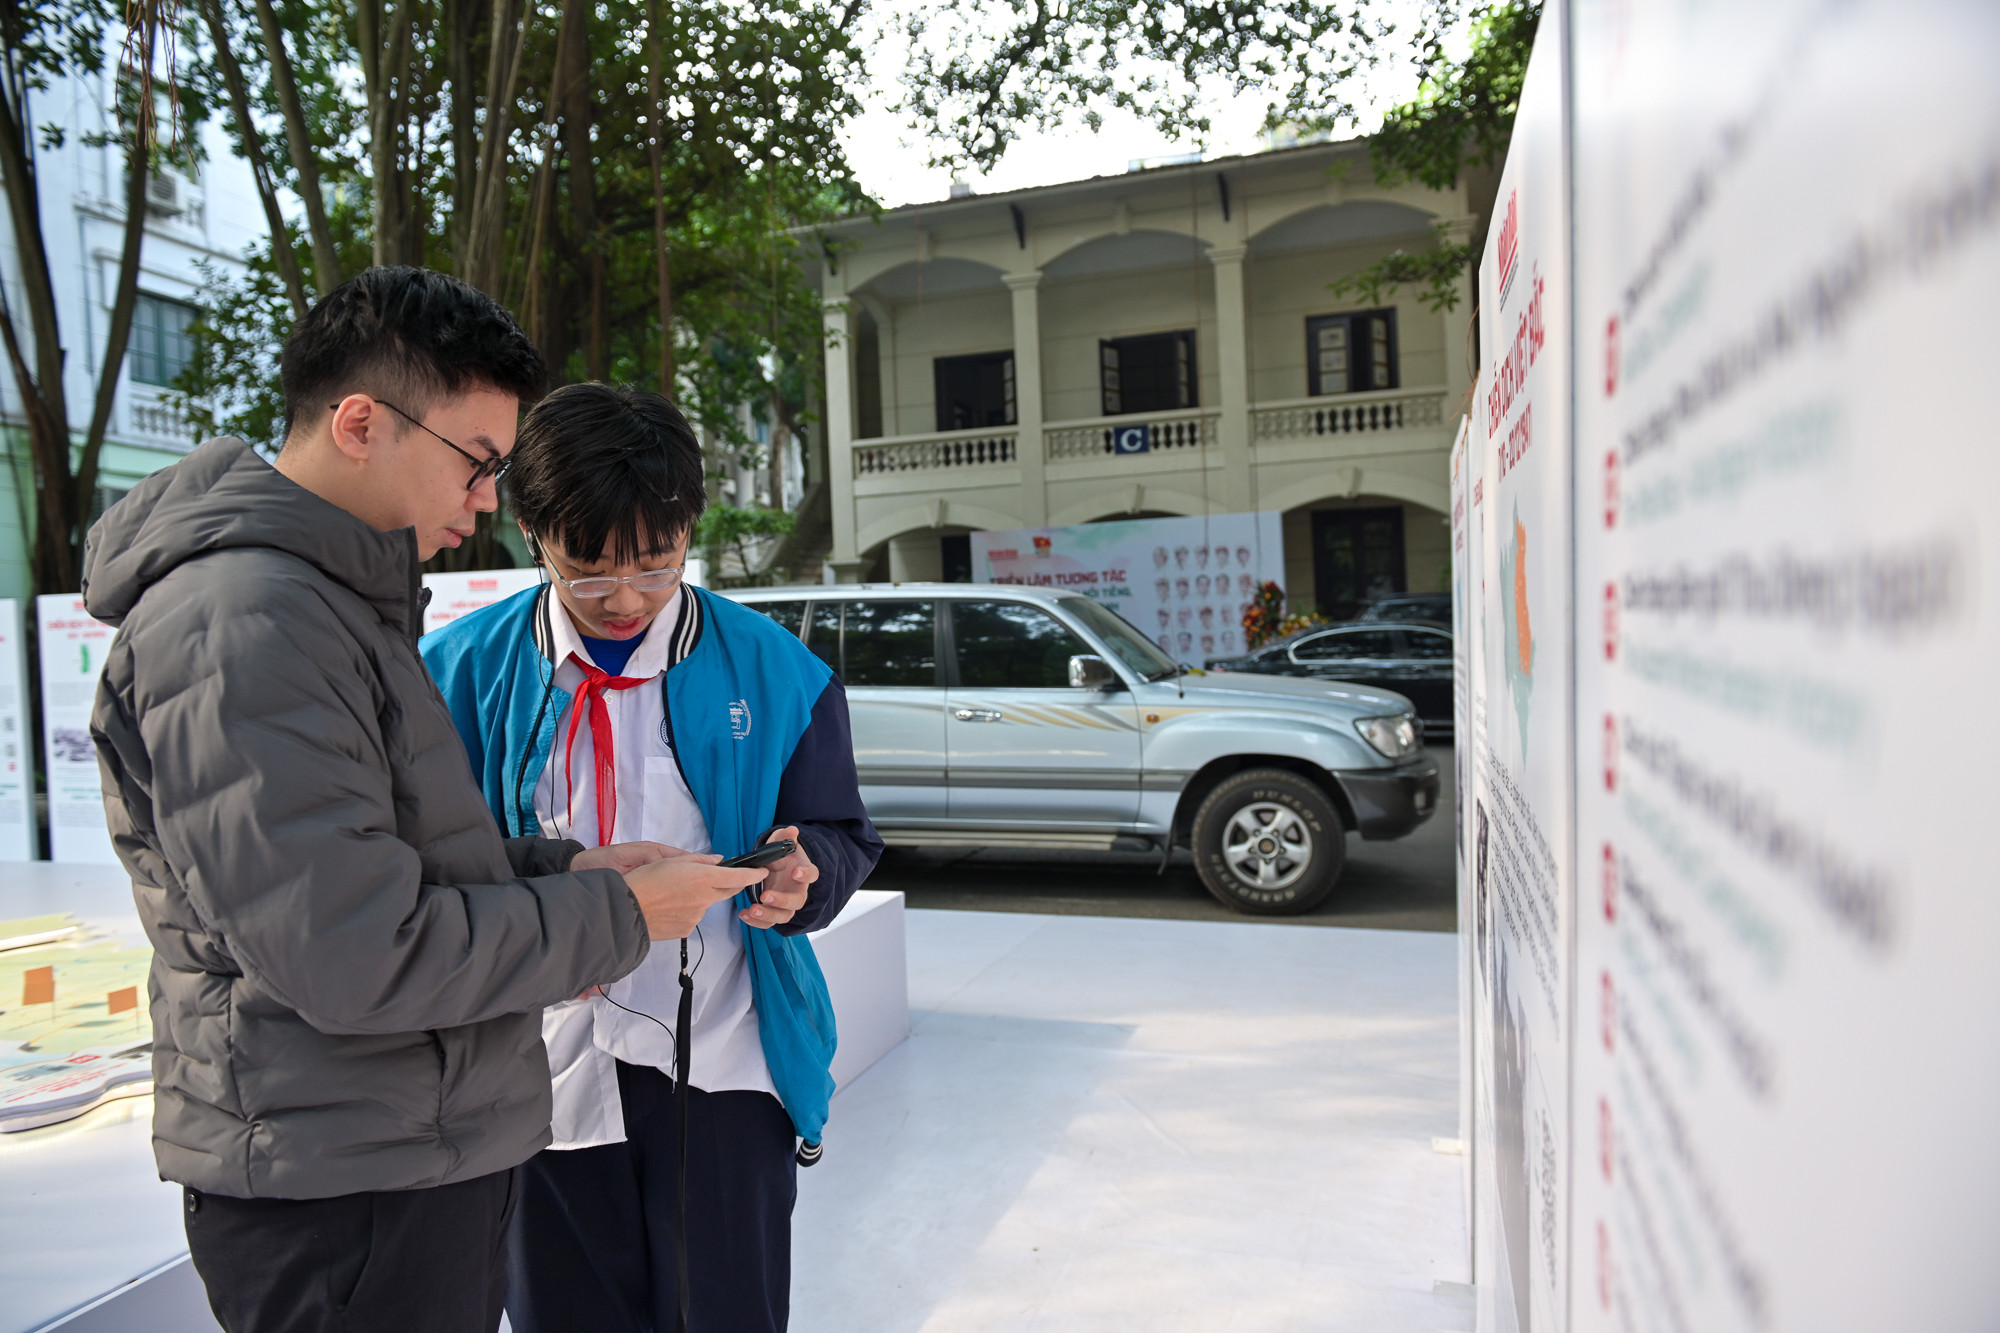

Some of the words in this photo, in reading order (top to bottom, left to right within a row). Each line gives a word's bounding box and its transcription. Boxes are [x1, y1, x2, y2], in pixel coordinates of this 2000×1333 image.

[1514, 311, 1528, 393] VIỆT
[1529, 259, 1545, 368] BẮC
[1120, 428, 1143, 452] C
